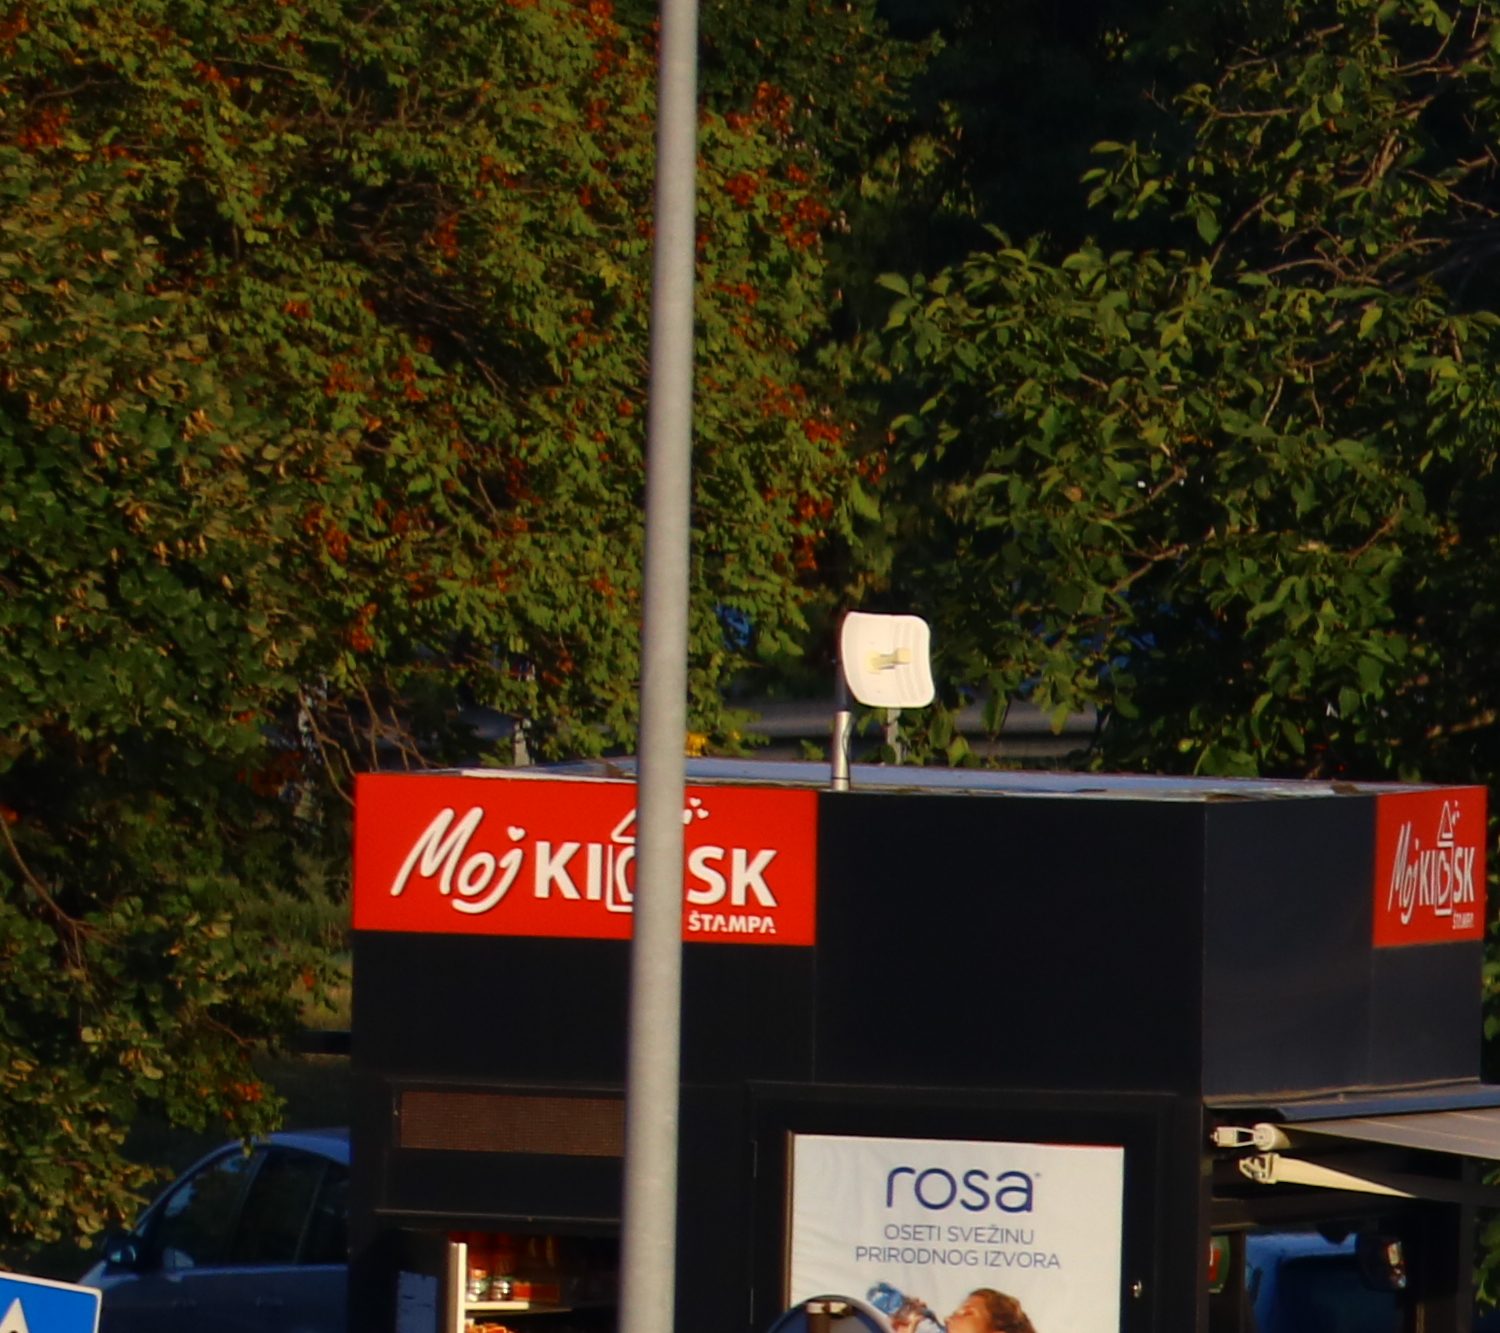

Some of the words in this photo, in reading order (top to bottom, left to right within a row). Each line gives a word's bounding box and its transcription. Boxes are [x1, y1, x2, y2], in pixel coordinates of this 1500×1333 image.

[388, 806, 526, 914] Moj
[1387, 821, 1419, 925] Moj
[1419, 847, 1475, 907] KIOSK
[687, 909, 777, 934] ŠTAMPA
[886, 1166, 1033, 1213] rosa
[884, 1223, 941, 1242] OSETI
[947, 1223, 1034, 1245] SVEŽINU
[855, 1245, 979, 1266] PRIRODNOG
[984, 1250, 1061, 1269] IZVORA
